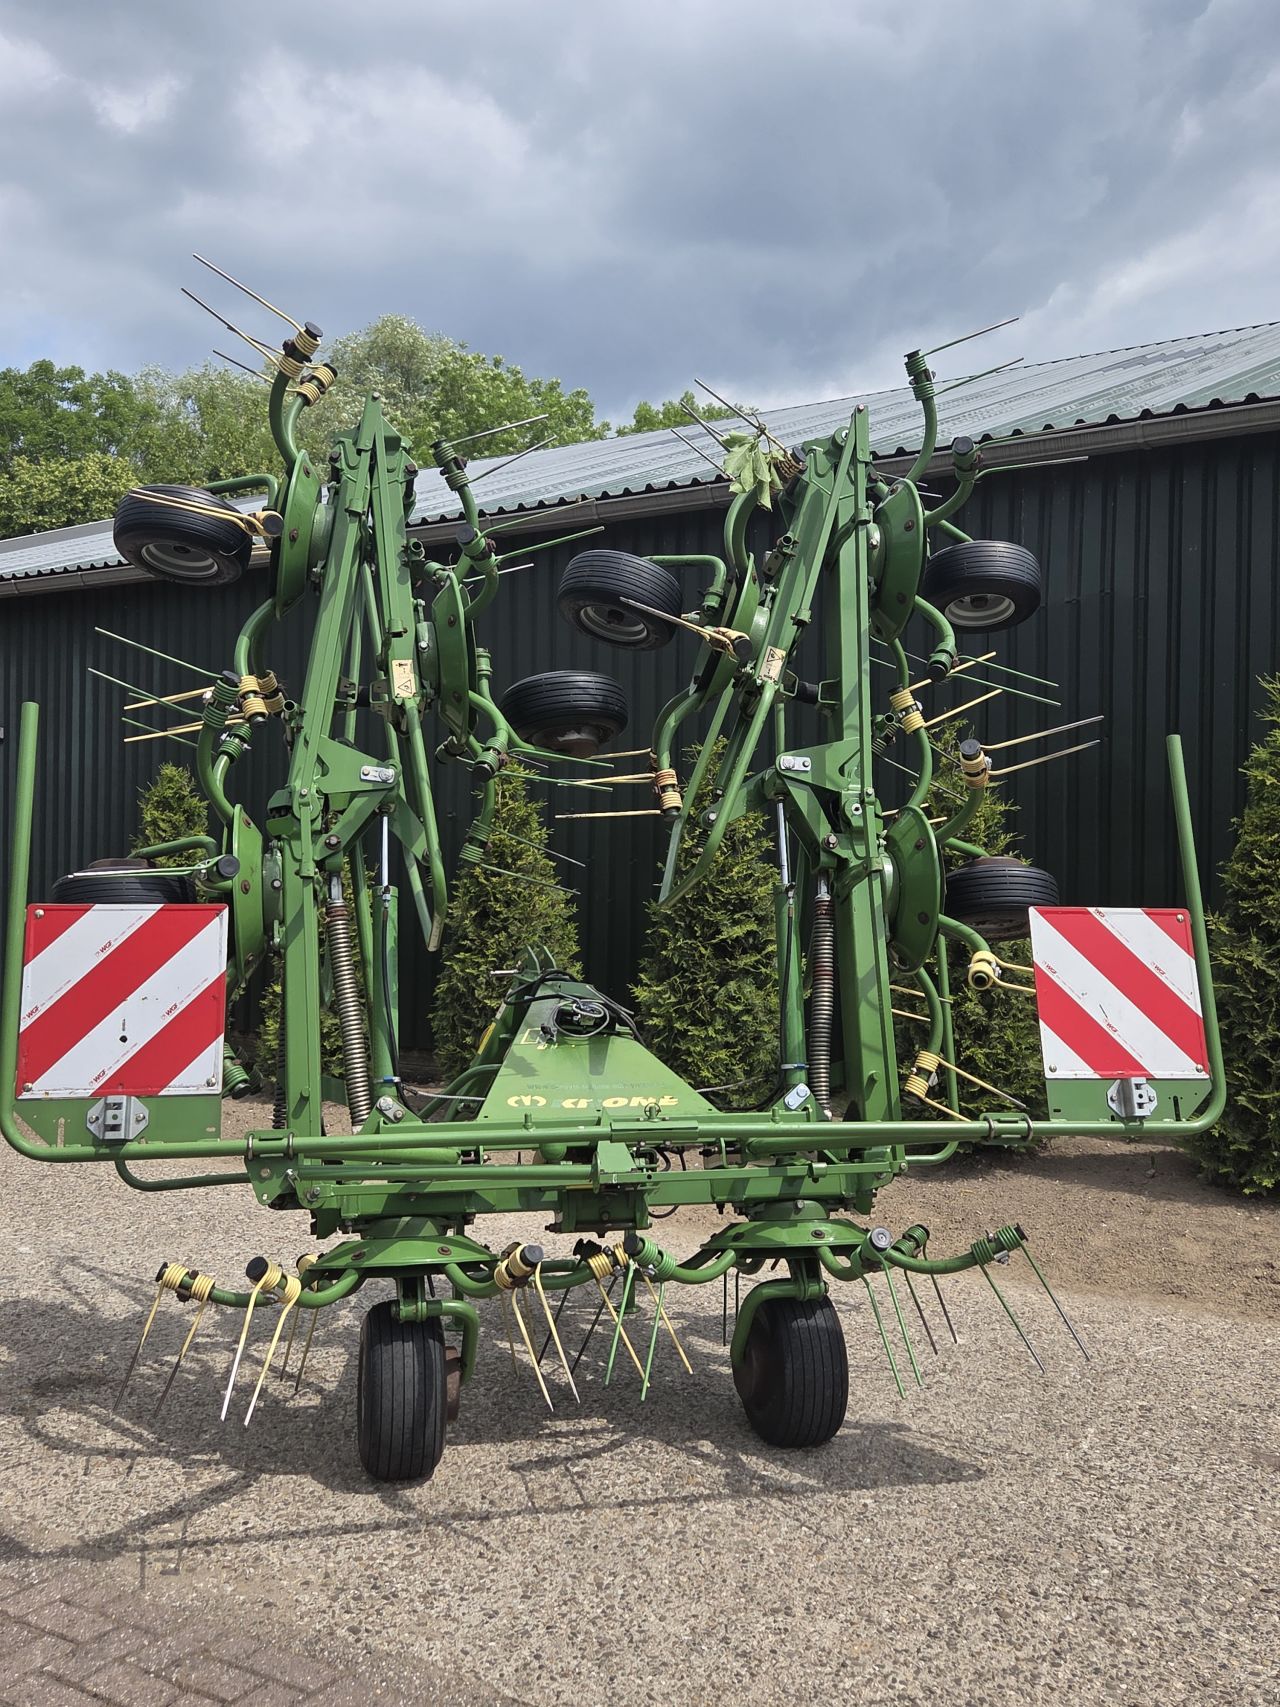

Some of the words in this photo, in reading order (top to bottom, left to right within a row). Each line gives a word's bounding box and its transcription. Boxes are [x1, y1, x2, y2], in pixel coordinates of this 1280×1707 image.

[99, 939, 113, 954] WGF
[1045, 963, 1058, 975] WGF
[1154, 964, 1166, 975] WGF
[26, 1004, 41, 1019] WGF
[165, 1003, 178, 1016] WGF
[1106, 1022, 1118, 1033] WGF
[93, 1069, 107, 1084] WGF
